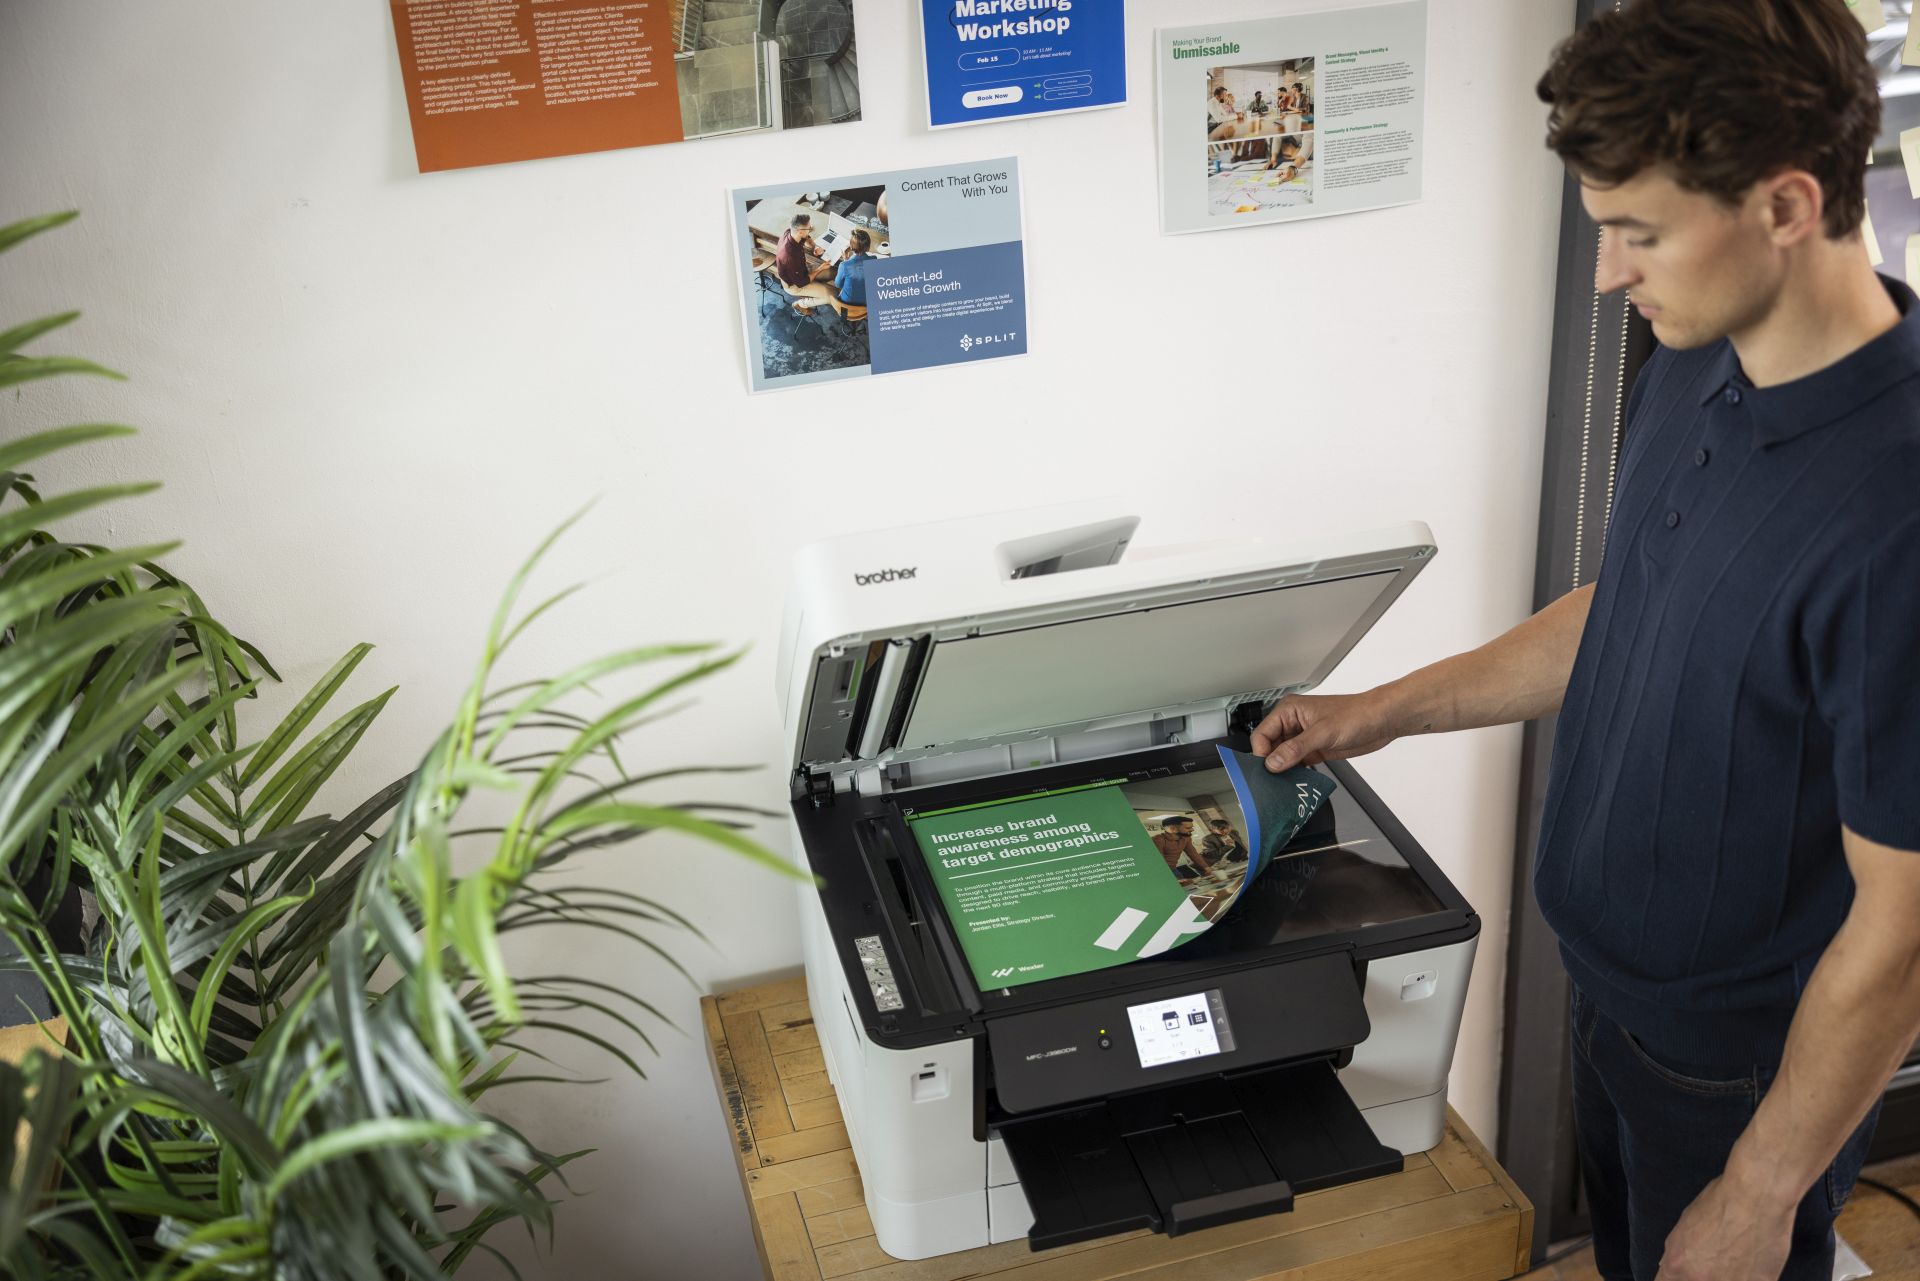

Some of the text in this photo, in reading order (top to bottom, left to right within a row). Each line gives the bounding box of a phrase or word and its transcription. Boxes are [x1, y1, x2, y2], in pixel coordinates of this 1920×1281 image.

[956, 16, 1070, 41] Workshop
[1173, 38, 1192, 46] Making
[1173, 43, 1240, 60] Unmissable
[902, 170, 1007, 192] Content That Grows
[962, 184, 1008, 198] With You
[876, 270, 943, 287] Content-Led
[878, 281, 961, 300] Website Growth
[976, 333, 1016, 345] SPLIT
[855, 567, 917, 586] brother
[931, 814, 1057, 844] Increase brand
[938, 822, 1091, 856] awareness among
[942, 829, 1119, 868] target demographics
[956, 888, 982, 898] through
[990, 879, 1036, 892] multi-platform
[1038, 874, 1063, 883] strategy
[1065, 870, 1078, 878] that
[1080, 866, 1106, 876] includes
[1108, 860, 1135, 871] targeted
[964, 882, 991, 892] position
[1004, 875, 1024, 884] brand
[1025, 872, 1045, 880] within
[1072, 862, 1100, 872] audience
[1102, 856, 1134, 867] segments
[959, 893, 986, 903] content,
[988, 889, 1002, 899] paid
[1004, 886, 1027, 894] media,
[1043, 876, 1078, 887] community
[961, 896, 992, 908] designed
[1020, 888, 1040, 897] reach,
[1086, 876, 1105, 885] brand
[1107, 873, 1124, 882] recall
[976, 903, 990, 911] next
[969, 917, 1000, 926] Presented
[972, 924, 991, 933] Jordan
[1018, 963, 1044, 972] Wexler
